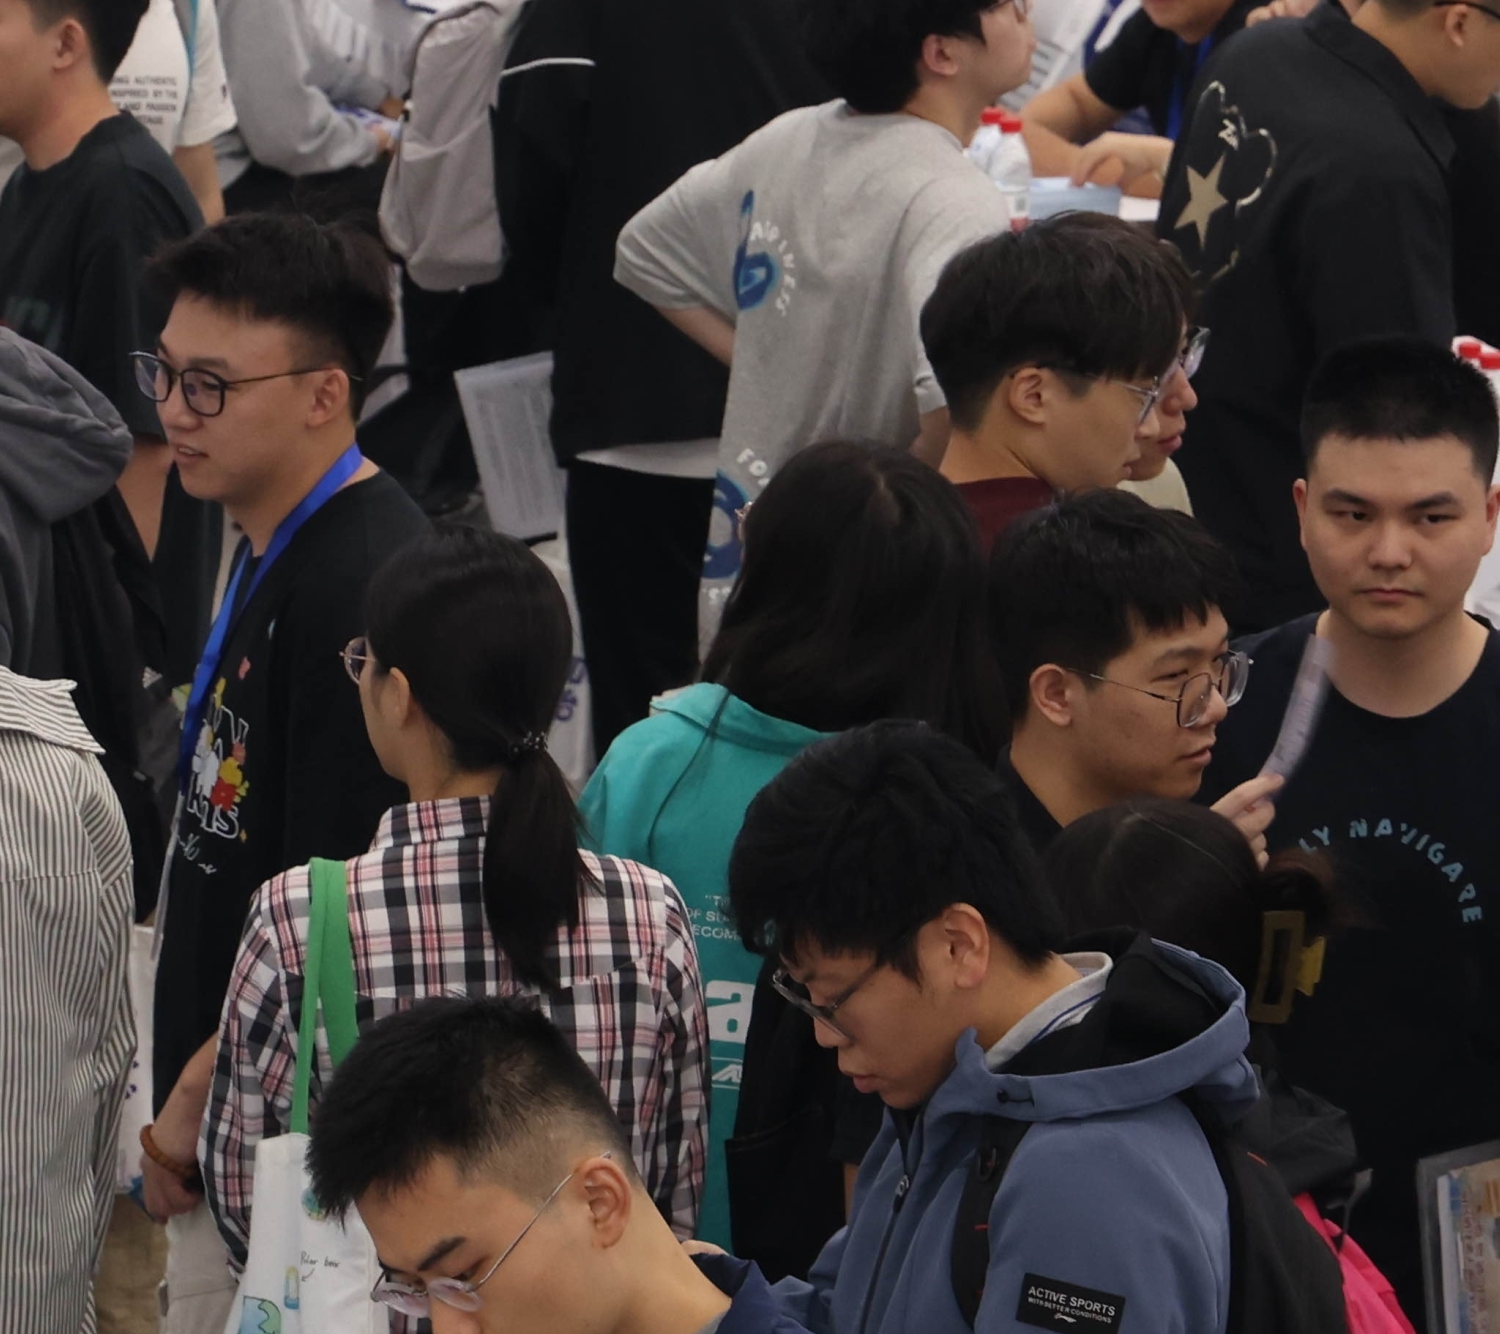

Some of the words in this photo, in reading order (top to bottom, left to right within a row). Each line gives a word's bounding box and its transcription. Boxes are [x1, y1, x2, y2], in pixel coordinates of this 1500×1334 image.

[1028, 1286, 1067, 1305] ACTIVE
[1069, 1296, 1116, 1317] SPORTS
[1070, 1308, 1113, 1324] CONDITIONS
